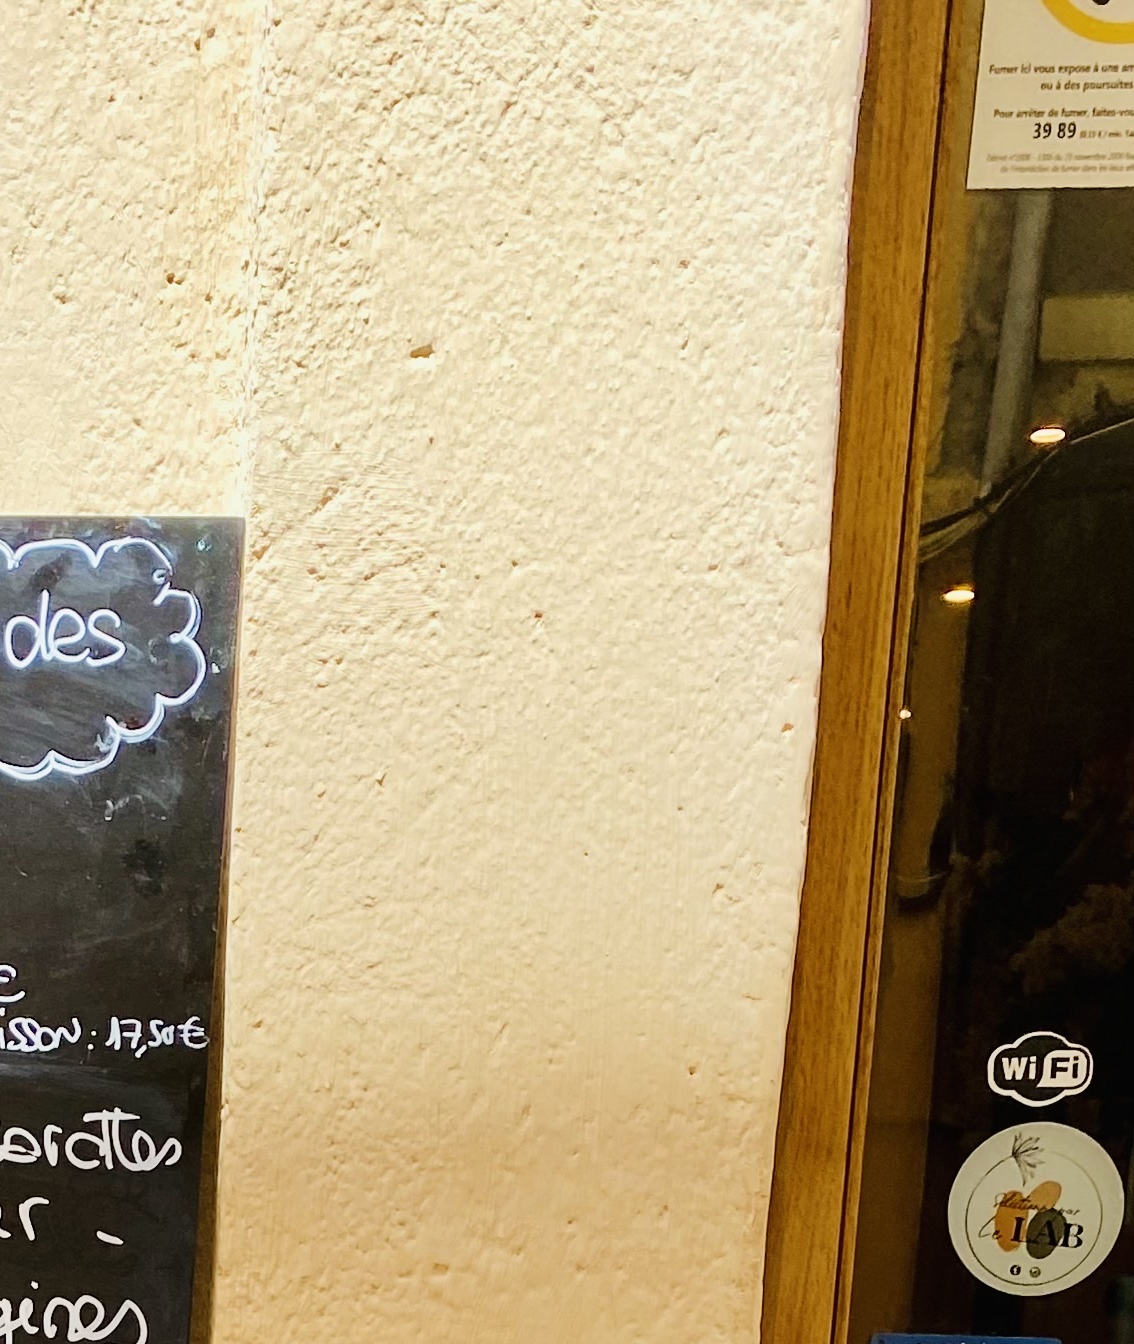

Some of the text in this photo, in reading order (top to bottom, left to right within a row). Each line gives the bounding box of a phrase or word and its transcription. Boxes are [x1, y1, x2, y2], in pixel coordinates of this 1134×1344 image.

[989, 64, 1018, 74] Fumer
[1058, 65, 1090, 75] expose
[1101, 65, 1118, 73] une
[1040, 82, 1053, 91] ou
[1064, 80, 1080, 91] des
[1082, 80, 1134, 92] poursuites
[1032, 122, 1052, 139] 39
[1056, 121, 1077, 139] 89
[2, 588, 126, 669] des
